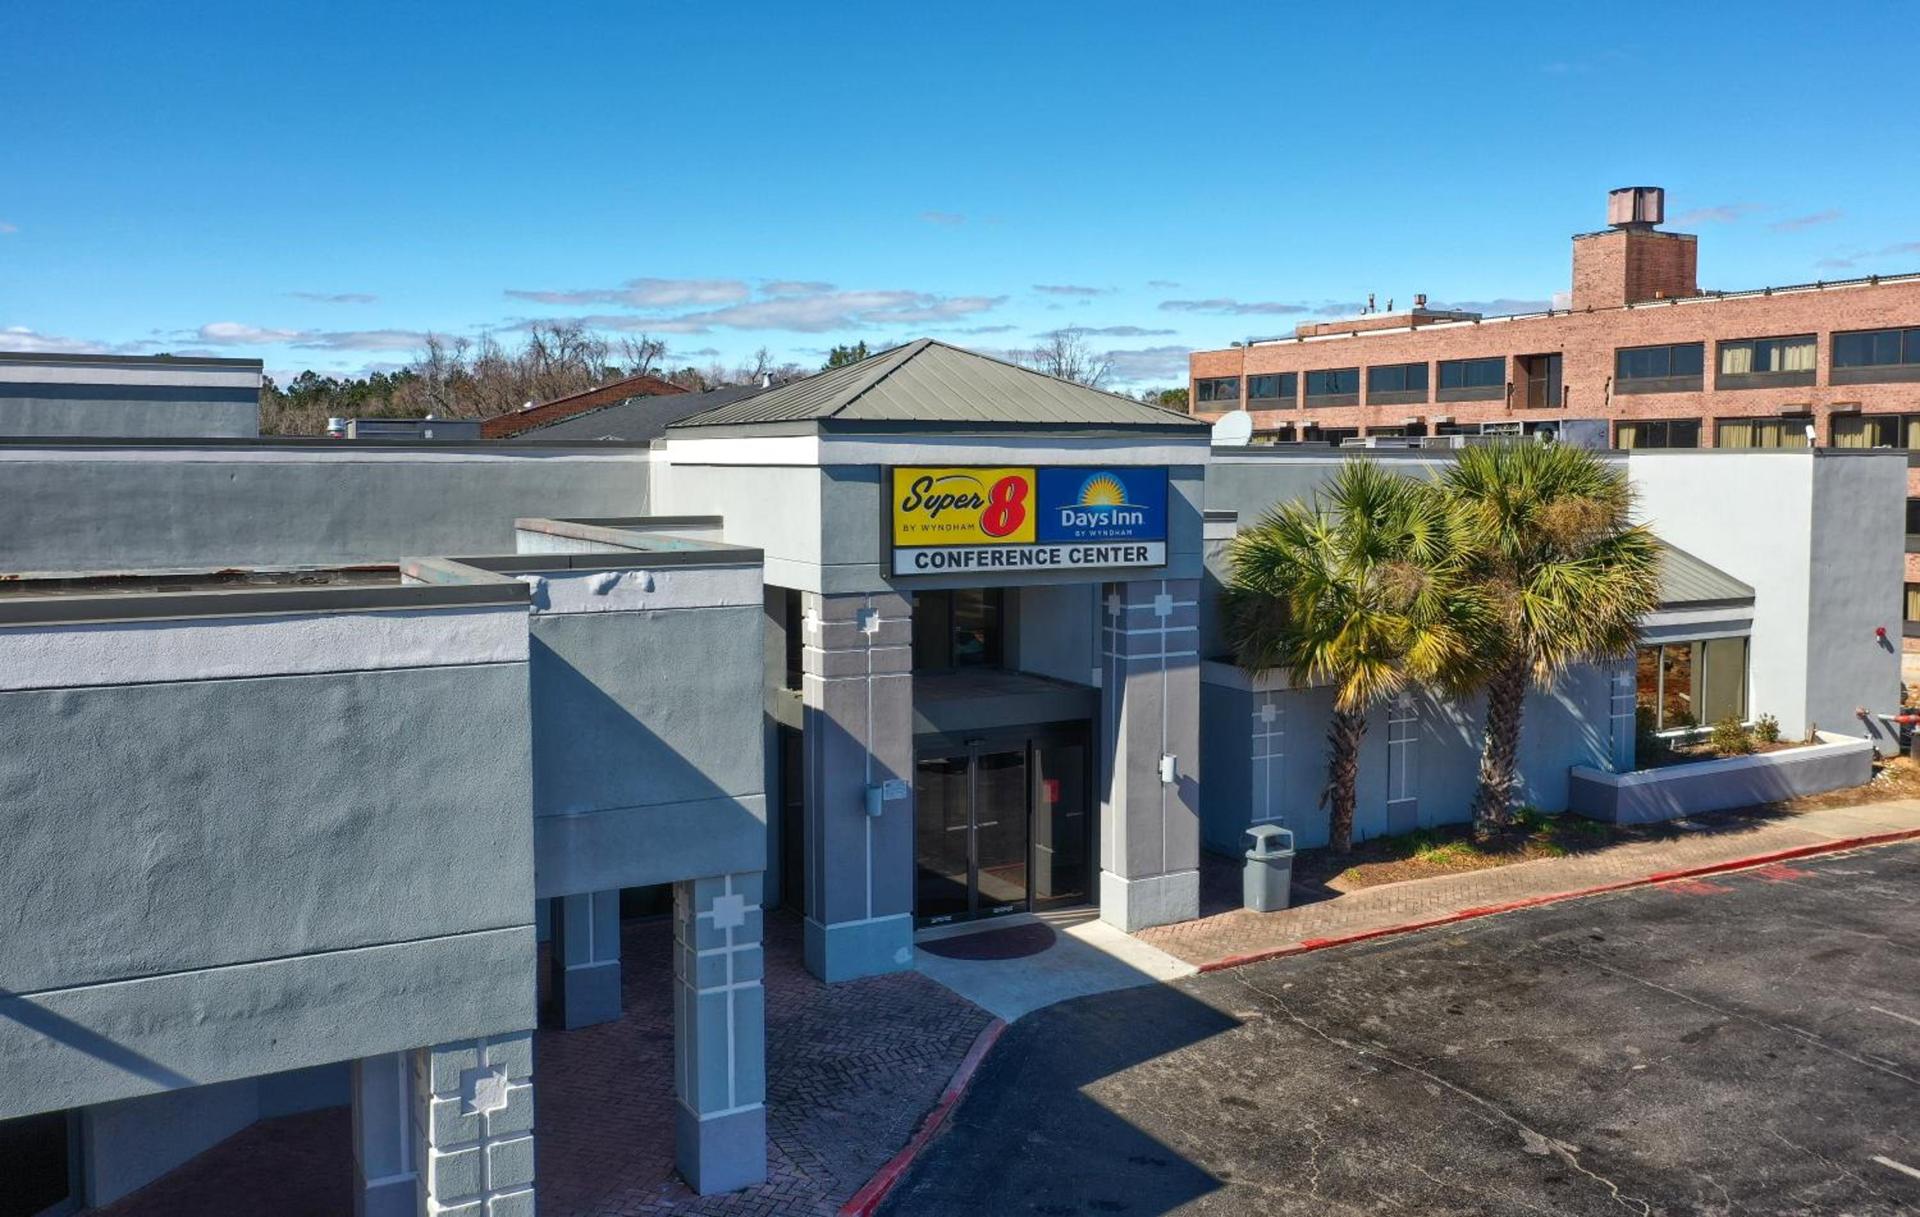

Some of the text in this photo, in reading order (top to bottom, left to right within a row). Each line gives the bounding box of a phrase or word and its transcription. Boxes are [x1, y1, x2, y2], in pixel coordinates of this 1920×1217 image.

[902, 475, 1030, 537] Super 8
[903, 522, 975, 532] BY WYNDHAM
[1061, 509, 1143, 528] Days Inn
[1089, 529, 1133, 537] WYNDHAM
[914, 546, 1149, 569] CONFERENCE CENTER
